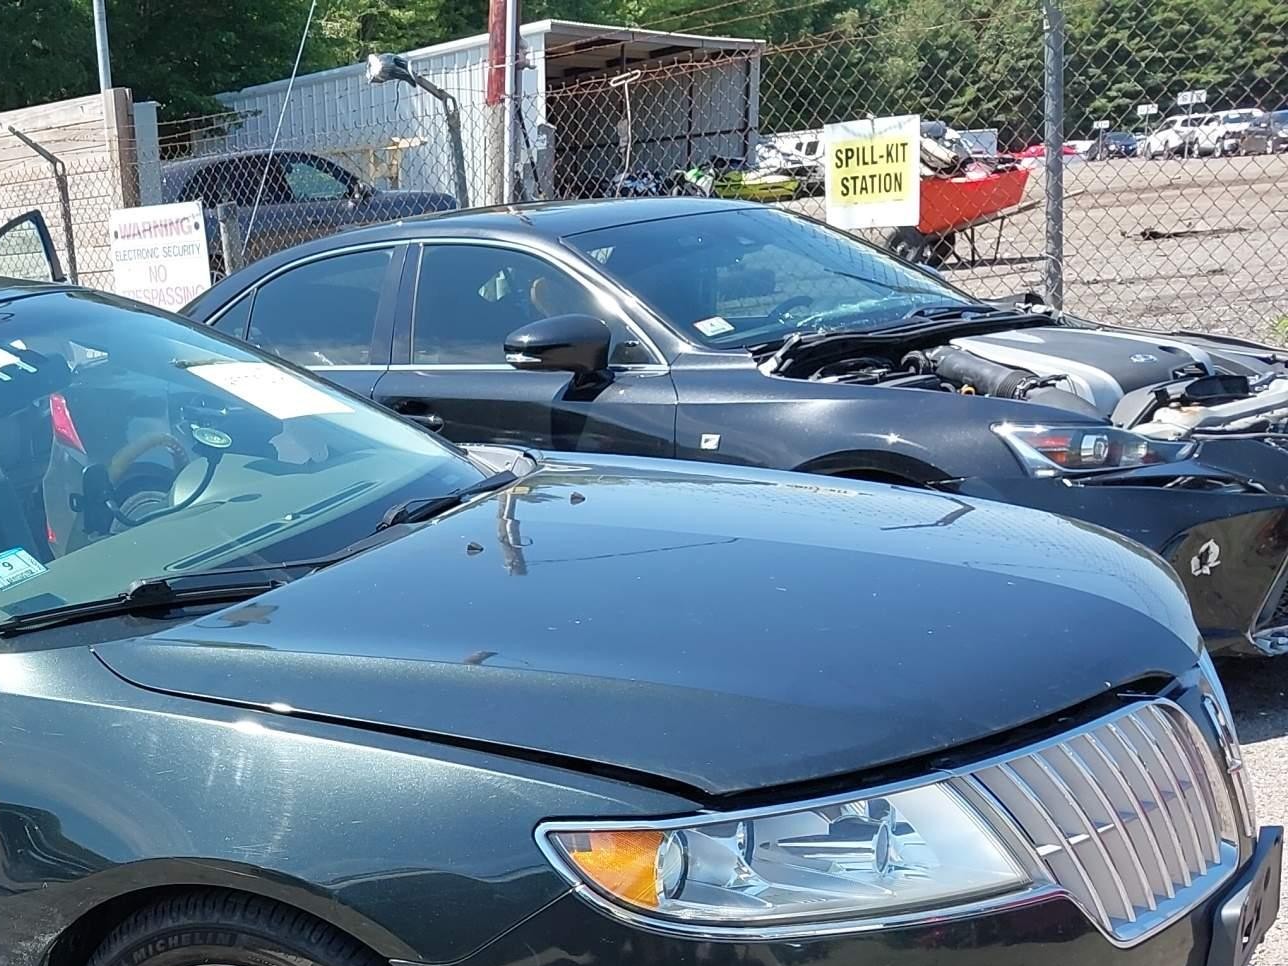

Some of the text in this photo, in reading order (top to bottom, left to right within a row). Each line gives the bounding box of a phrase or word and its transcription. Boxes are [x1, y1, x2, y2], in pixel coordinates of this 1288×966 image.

[835, 142, 908, 169] SPILL-KIT
[841, 172, 902, 197] STATION
[118, 217, 192, 240] WARNING
[115, 243, 201, 262] ELECTRONIC SECURITY
[149, 264, 168, 283] NO
[132, 932, 232, 963] MICHELIN
